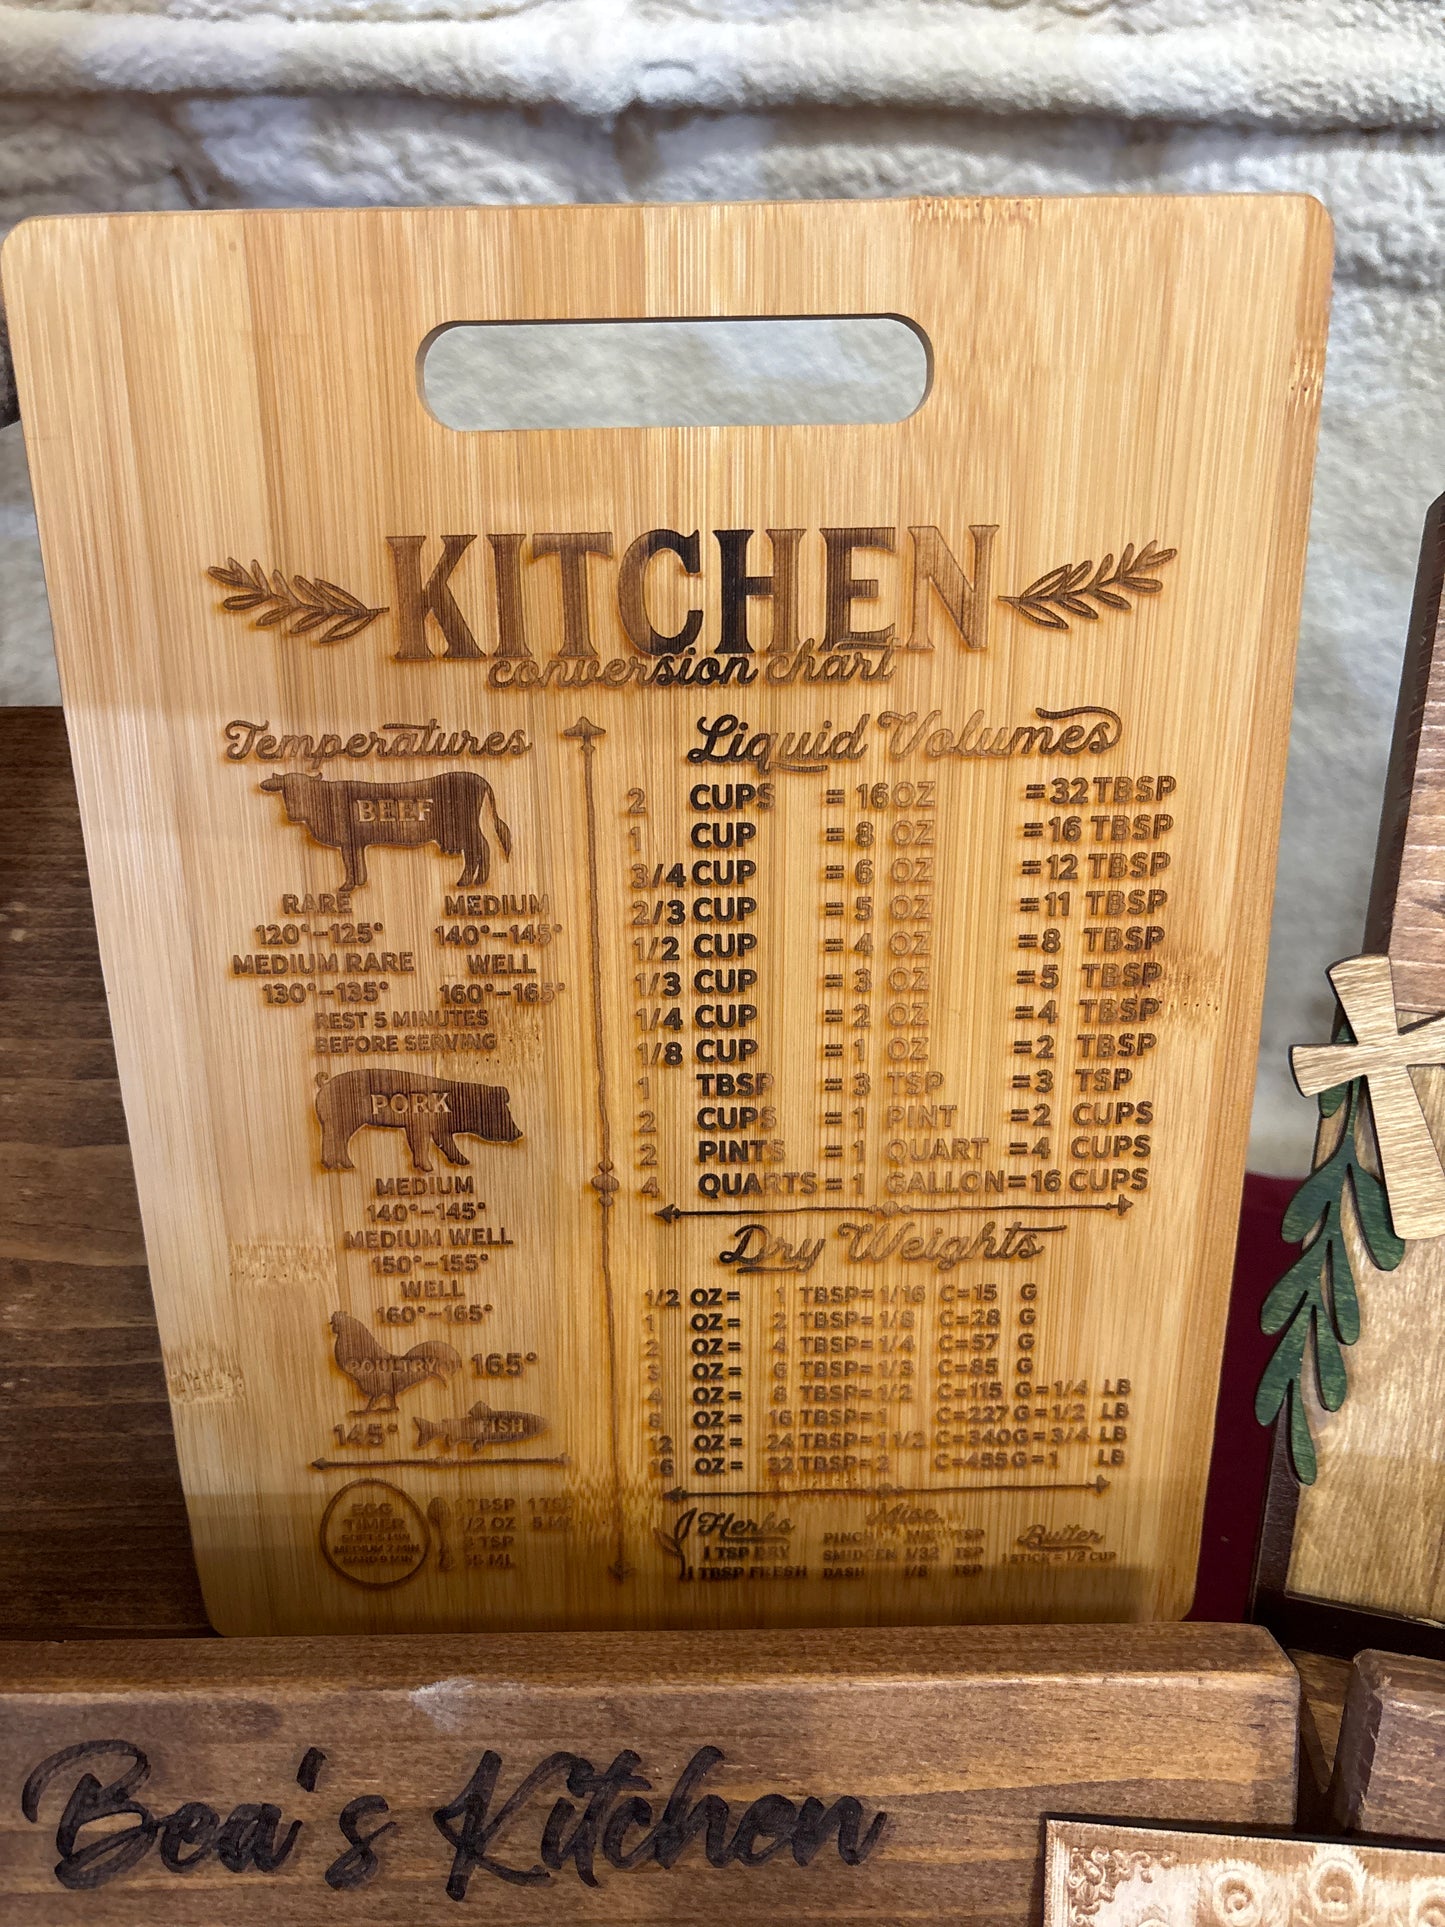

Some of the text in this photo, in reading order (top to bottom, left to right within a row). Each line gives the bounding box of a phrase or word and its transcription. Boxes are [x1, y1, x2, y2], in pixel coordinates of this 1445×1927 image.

[385, 525, 999, 661] KITCHEN
[488, 637, 902, 691] conversion chart
[225, 719, 532, 769] Temperatures
[687, 705, 1122, 775] Liquid Volumes
[628, 788, 646, 814] 2
[690, 783, 775, 810] CUPS
[1093, 775, 1177, 803] TBSP
[357, 799, 434, 822] BEEF
[691, 823, 756, 849] CUP
[892, 820, 935, 846] OZ
[1091, 814, 1174, 841] TBSP
[632, 863, 686, 888] 3/4
[692, 860, 756, 886] CUP
[890, 858, 933, 883] OZ
[1088, 852, 1171, 879] TBSP
[283, 894, 353, 914] RARE
[445, 894, 549, 916] MEDIUM
[632, 900, 686, 925] 2/3
[693, 897, 757, 922] CUP
[890, 895, 933, 920] OZ
[1086, 890, 1168, 915] TBSP
[633, 936, 680, 961] 1/2
[694, 933, 757, 958] CUP
[890, 931, 931, 956] OZ
[1083, 926, 1165, 952] TBSP
[233, 952, 414, 975] MEDIUM RARE
[467, 954, 536, 975] WELL
[634, 972, 681, 996] 1/3
[694, 969, 757, 994] CUP
[888, 967, 930, 992] OZ
[1081, 962, 1162, 988] TBSP
[315, 1009, 488, 1029] REST 5 MINUTES
[636, 1008, 683, 1031] 1/4
[695, 1005, 757, 1029] CUP
[888, 1002, 929, 1027] OZ
[1079, 997, 1160, 1024] TBSP
[315, 1034, 497, 1053] BEFORE SERVING
[637, 1042, 683, 1066] 1/8
[696, 1039, 758, 1063] CUP
[888, 1037, 929, 1061] OZ
[1077, 1033, 1157, 1058] TBSP
[696, 1073, 774, 1097] TBSP
[888, 1071, 944, 1095] TSP
[1075, 1068, 1132, 1092] TSP
[371, 1092, 452, 1115] PORK
[639, 1110, 656, 1133] 2
[697, 1106, 776, 1131] CUPS
[887, 1104, 957, 1128] PINT
[1073, 1101, 1153, 1126] CUPS
[640, 1144, 657, 1166] 2
[699, 1139, 785, 1163] PINTS
[887, 1138, 989, 1164] QUART
[1071, 1134, 1151, 1159] CUPS
[376, 1177, 474, 1196] MEDIUM
[641, 1176, 660, 1198] 4
[698, 1172, 817, 1199] QUARTS
[1069, 1168, 1149, 1192] CUPS
[344, 1227, 513, 1248] MEDIUM WELL
[719, 1222, 1067, 1274] Dry Weights
[400, 1280, 464, 1299] WELL
[645, 1288, 680, 1307] 1/2
[348, 1358, 438, 1375] POULTRY
[471, 1352, 537, 1377] 165°
[1103, 1379, 1131, 1397] LB
[1101, 1402, 1129, 1420] LB
[334, 1423, 397, 1446] 145°
[479, 1418, 525, 1434] FISH
[1099, 1426, 1127, 1444] LB
[1098, 1449, 1125, 1466] LB
[343, 1518, 405, 1532] TIMER
[697, 1511, 796, 1544] Herbs
[1017, 1524, 1104, 1551] Butter
[1090, 1551, 1116, 1562] CUP
[21, 1737, 886, 1901] Bea's Kitchen
